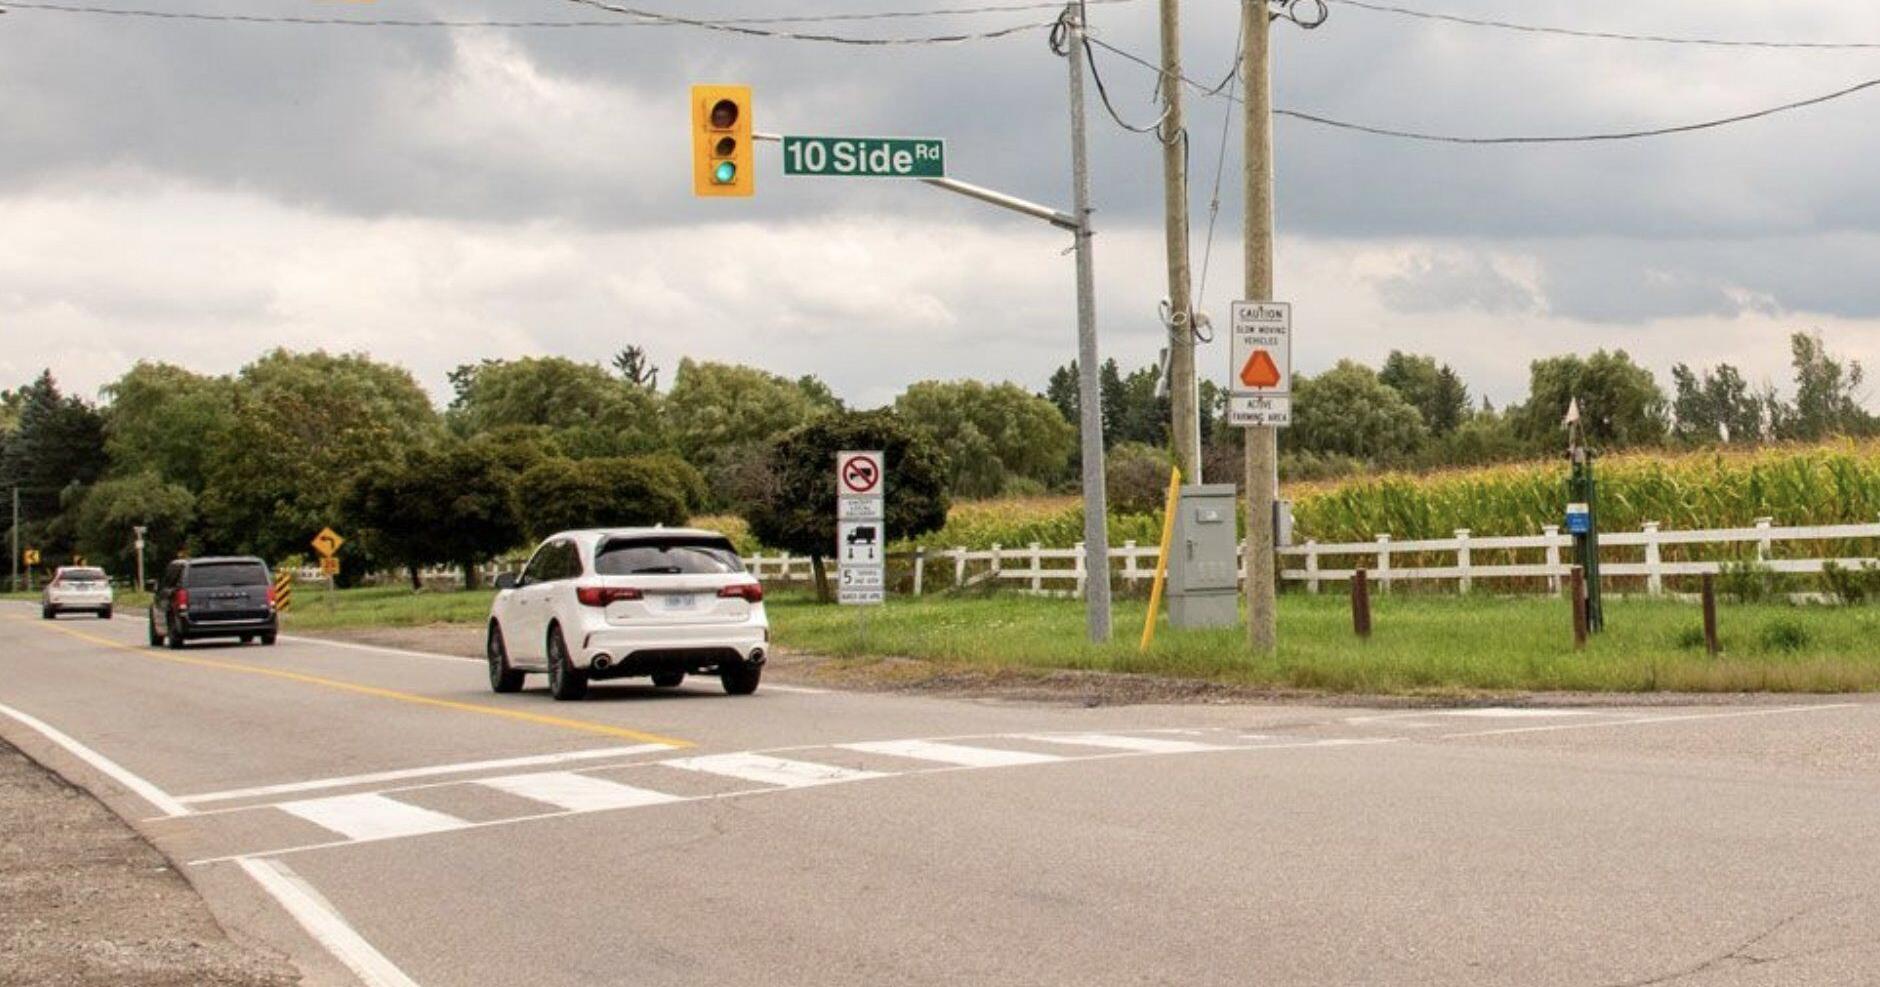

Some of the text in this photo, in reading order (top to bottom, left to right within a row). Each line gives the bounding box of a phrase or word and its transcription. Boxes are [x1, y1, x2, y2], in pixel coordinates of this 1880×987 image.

[788, 141, 940, 173] 10 Side Rd
[1239, 309, 1282, 319] CAUTION
[1258, 326, 1286, 335] MOVING
[844, 569, 852, 584] 5
